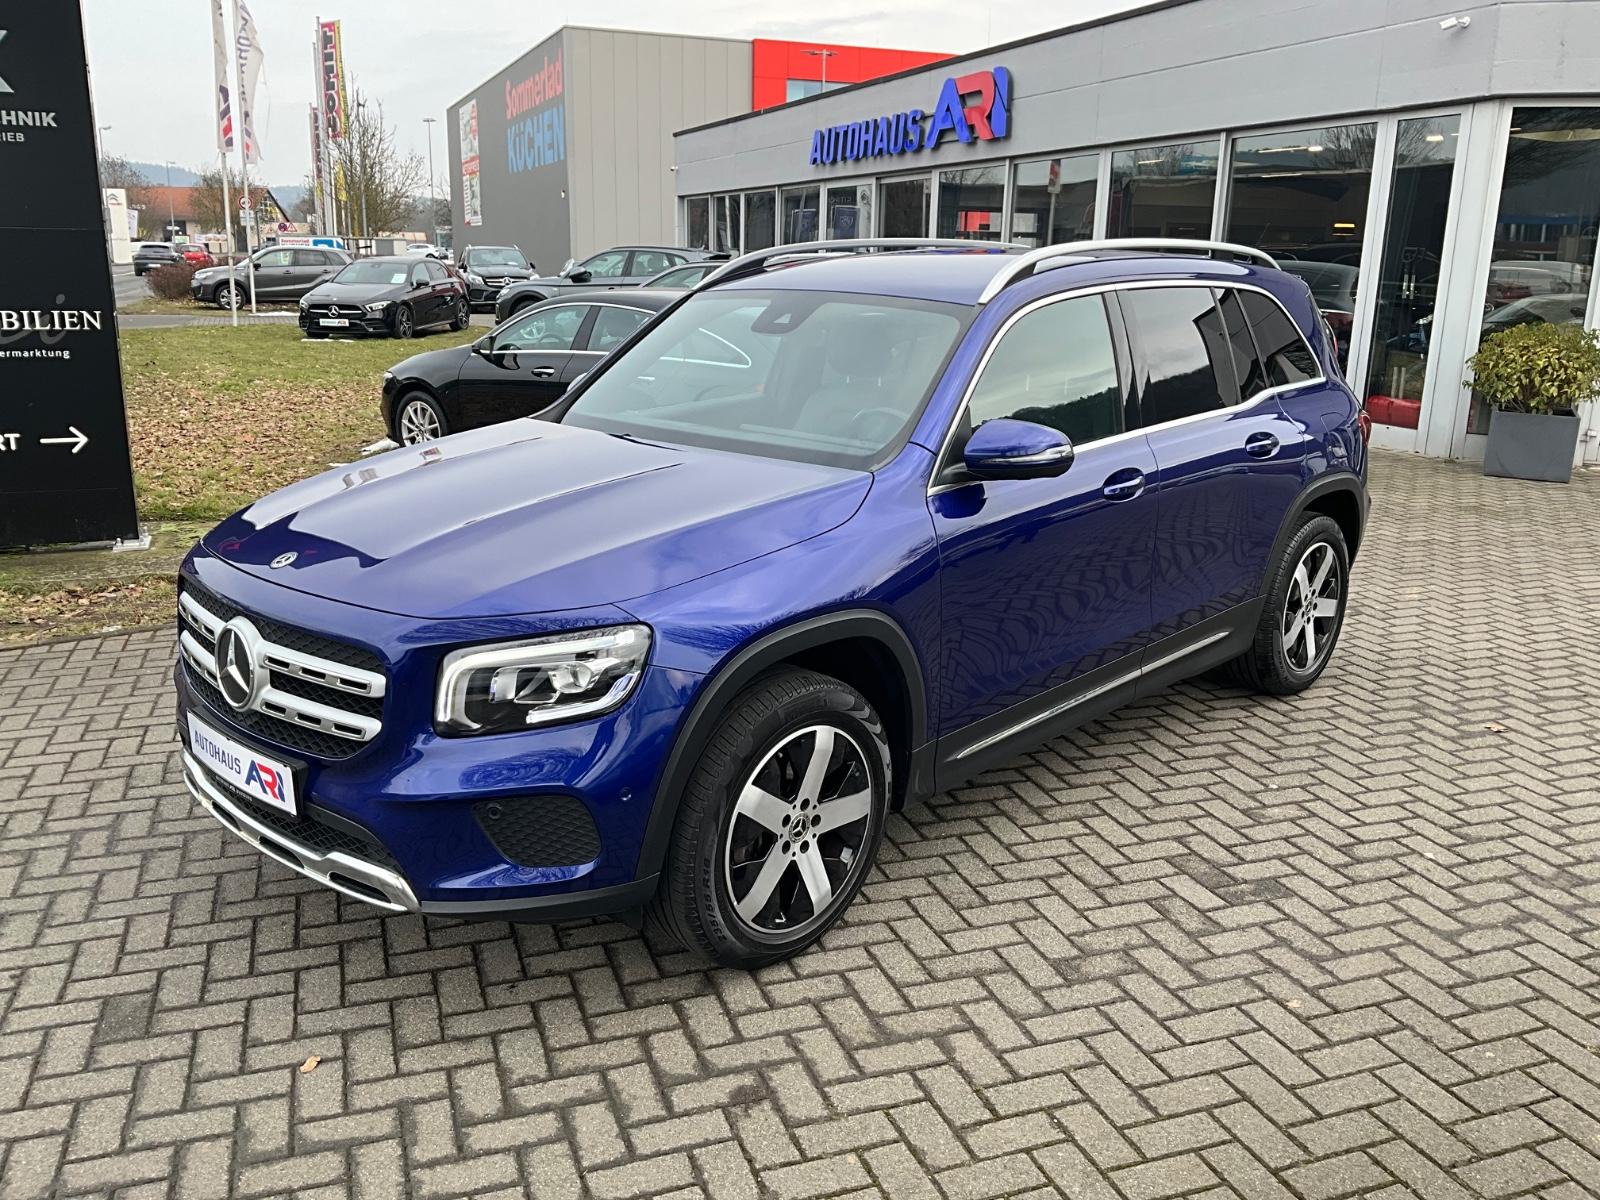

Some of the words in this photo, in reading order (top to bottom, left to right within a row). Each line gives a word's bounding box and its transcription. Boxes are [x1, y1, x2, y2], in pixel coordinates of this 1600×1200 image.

[505, 48, 563, 120] Sommerlad
[809, 109, 925, 165] AUTOHAUS
[924, 66, 1011, 149] ARI
[0, 132, 24, 142] IEB
[0, 310, 102, 330] BILIEN
[194, 730, 241, 775] AUTOHAUS
[245, 760, 285, 802] ARI
